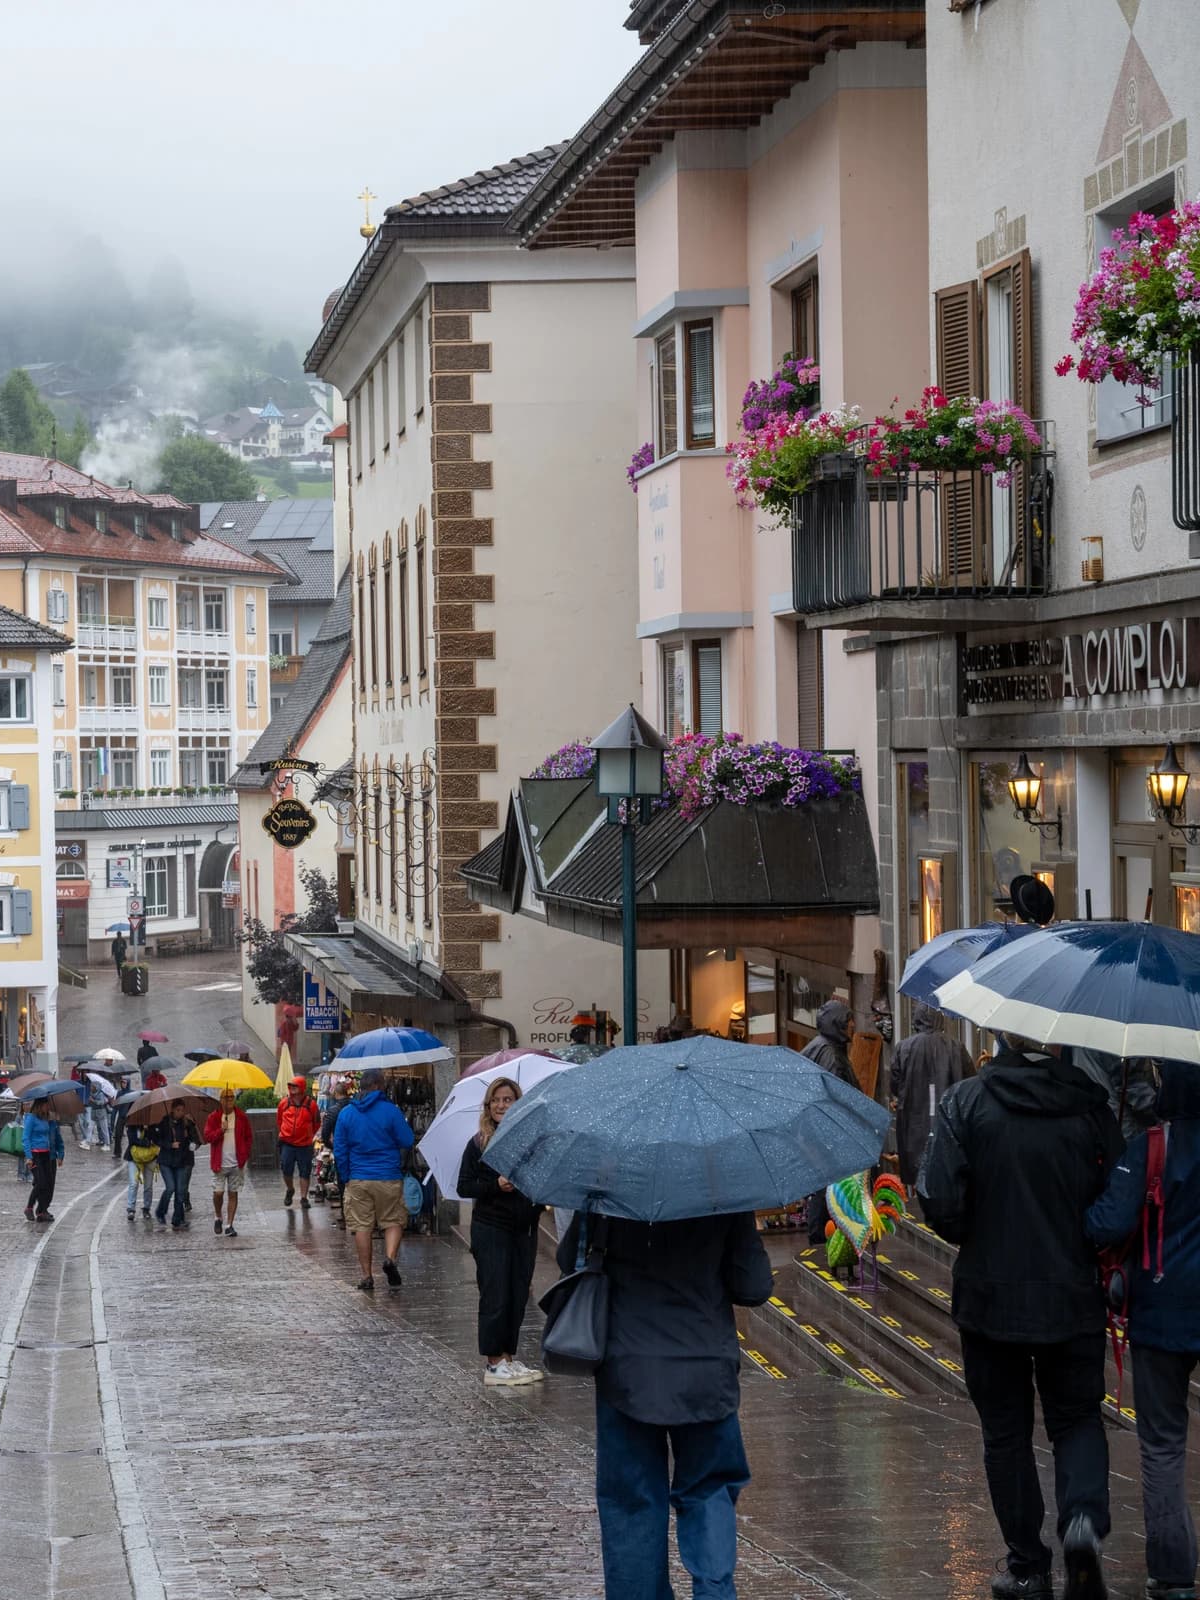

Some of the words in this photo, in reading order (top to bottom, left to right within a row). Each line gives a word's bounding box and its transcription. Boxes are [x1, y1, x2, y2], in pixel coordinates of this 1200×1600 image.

[1084, 617, 1188, 696] COMPLOJ
[270, 811, 310, 833] Souvenirs
[306, 1007, 339, 1017] TABACCHI
